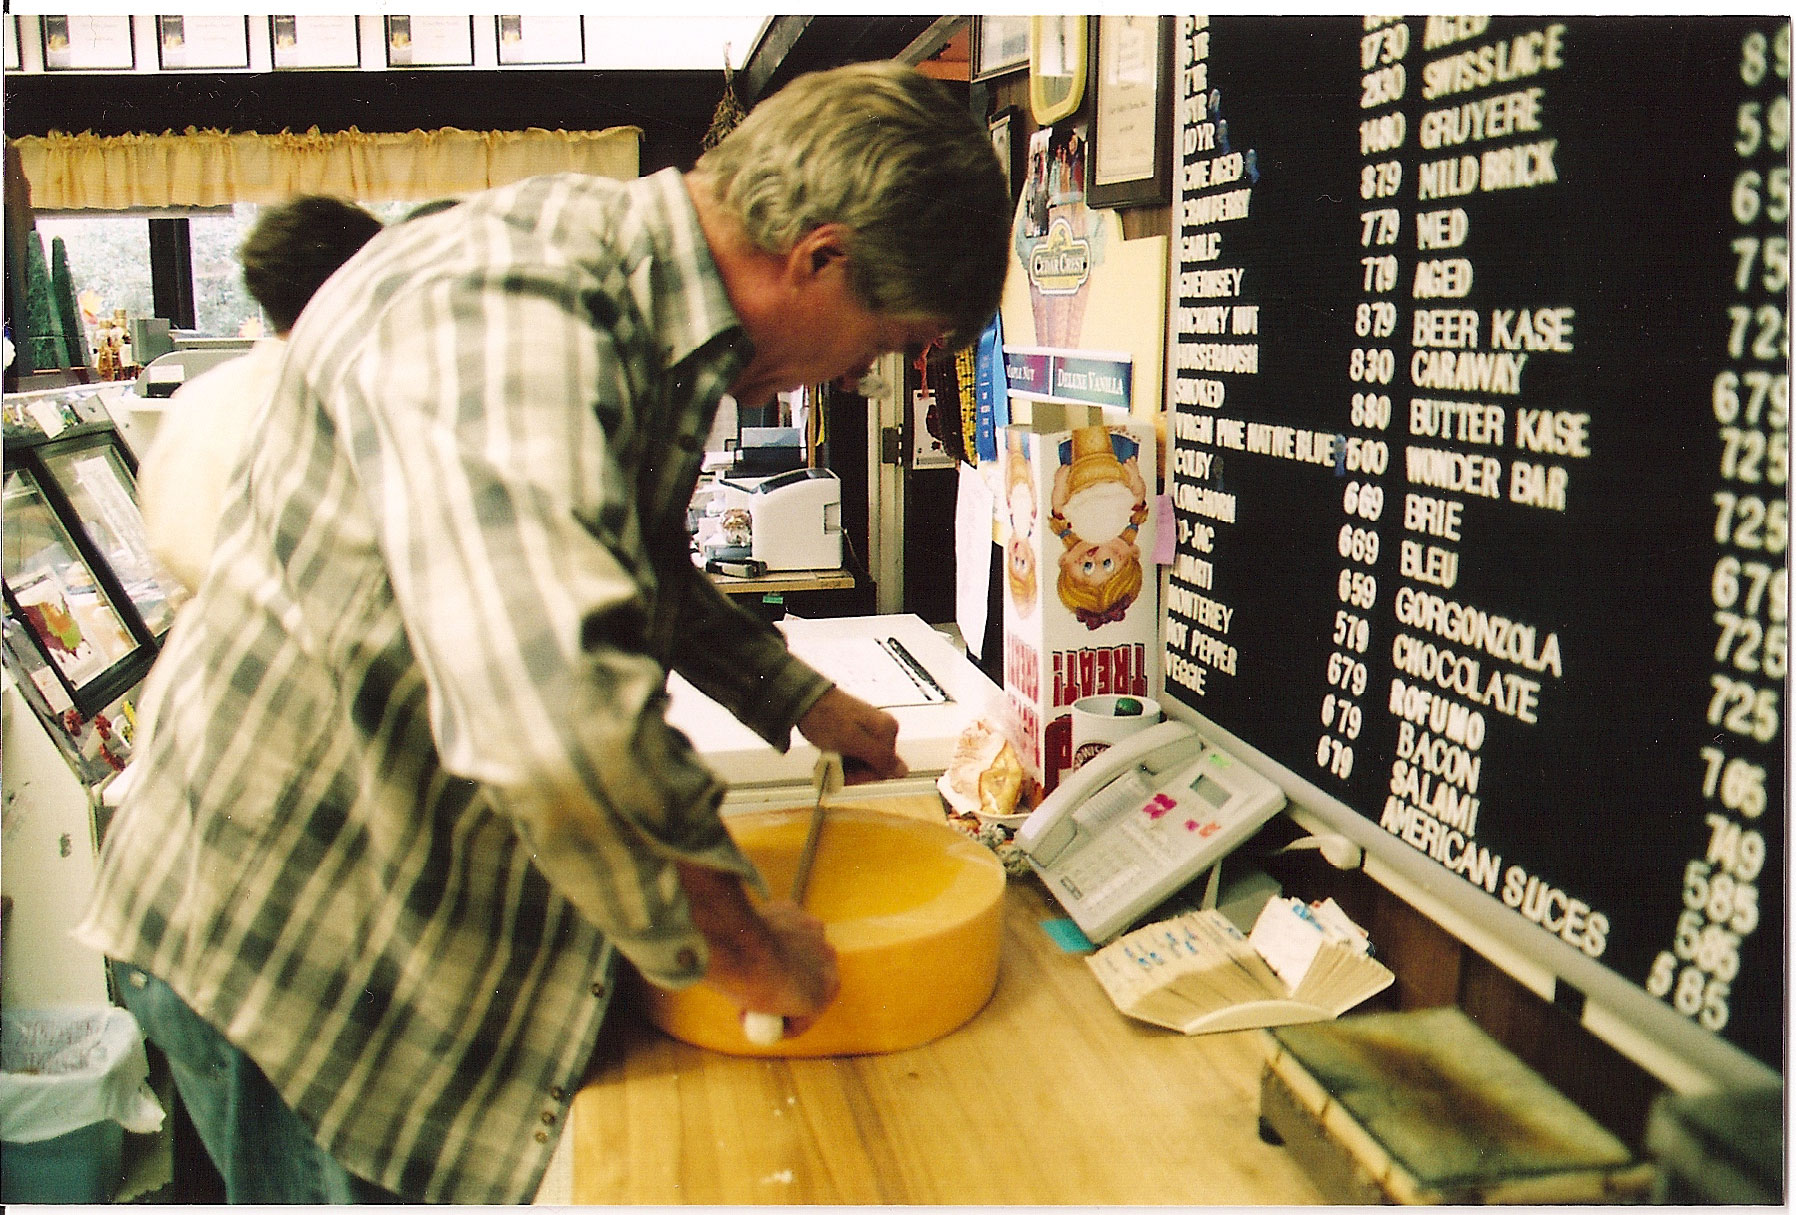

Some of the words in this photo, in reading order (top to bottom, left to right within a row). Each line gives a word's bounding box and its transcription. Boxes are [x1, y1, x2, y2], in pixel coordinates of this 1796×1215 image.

[1418, 87, 1546, 150] GRUYERE
[1360, 160, 1403, 200] 879
[1418, 154, 1480, 201] MILD
[1480, 138, 1559, 193] BRICK
[1360, 208, 1401, 247] 779
[1415, 207, 1469, 250] MED
[1361, 254, 1399, 292] 779
[1412, 258, 1474, 299] AGED
[1355, 301, 1397, 338] 879
[1412, 308, 1480, 350] BEER
[1490, 306, 1577, 353] KASE
[1350, 348, 1395, 385] 830
[1410, 349, 1530, 395] CARAWAY
[1350, 392, 1392, 431] 880
[1408, 398, 1506, 447] BUTTER
[1515, 406, 1592, 458] KASE
[1405, 445, 1502, 500] WONDER
[1509, 460, 1569, 513] BAR
[1403, 492, 1465, 542] BRIE
[1338, 522, 1380, 566] 669
[1400, 539, 1459, 589] BLEU
[1338, 568, 1377, 610] 659
[1333, 609, 1370, 654] 579
[1394, 586, 1563, 679] GORGONZOLA
[1052, 643, 1148, 707] TREAT!
[1327, 651, 1368, 697] 679
[1391, 632, 1542, 725] CHOCOLATE
[1321, 693, 1362, 740] 679
[1389, 677, 1486, 751] ROFUMO
[1705, 672, 1780, 743] 725
[1316, 734, 1354, 779] 679
[1396, 719, 1482, 795] BACON
[1389, 758, 1481, 838] SALAMI
[1379, 794, 1502, 894] AMERICAN
[1681, 858, 1761, 936] 585
[1646, 949, 1731, 1032] 585
